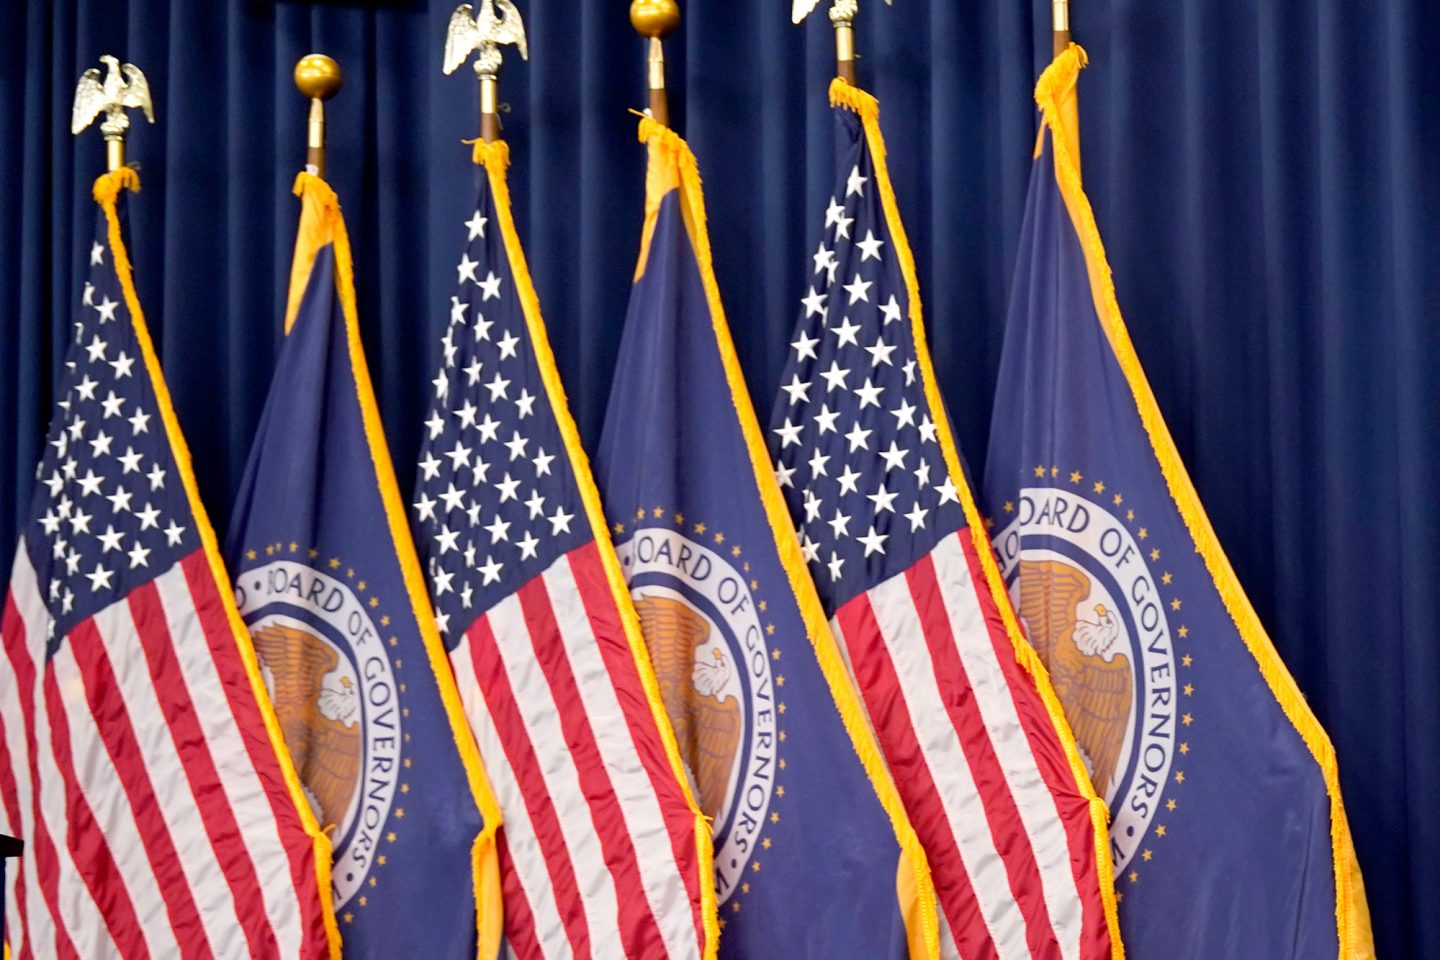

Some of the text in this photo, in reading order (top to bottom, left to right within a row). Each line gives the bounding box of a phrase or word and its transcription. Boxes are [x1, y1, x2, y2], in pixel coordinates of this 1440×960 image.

[347, 610, 374, 646] OF
[632, 535, 771, 854] OARD OF GOVERNORS
[1019, 496, 1171, 819] OARD OF GOVERNORS
[352, 656, 396, 868] GOVERNORS
